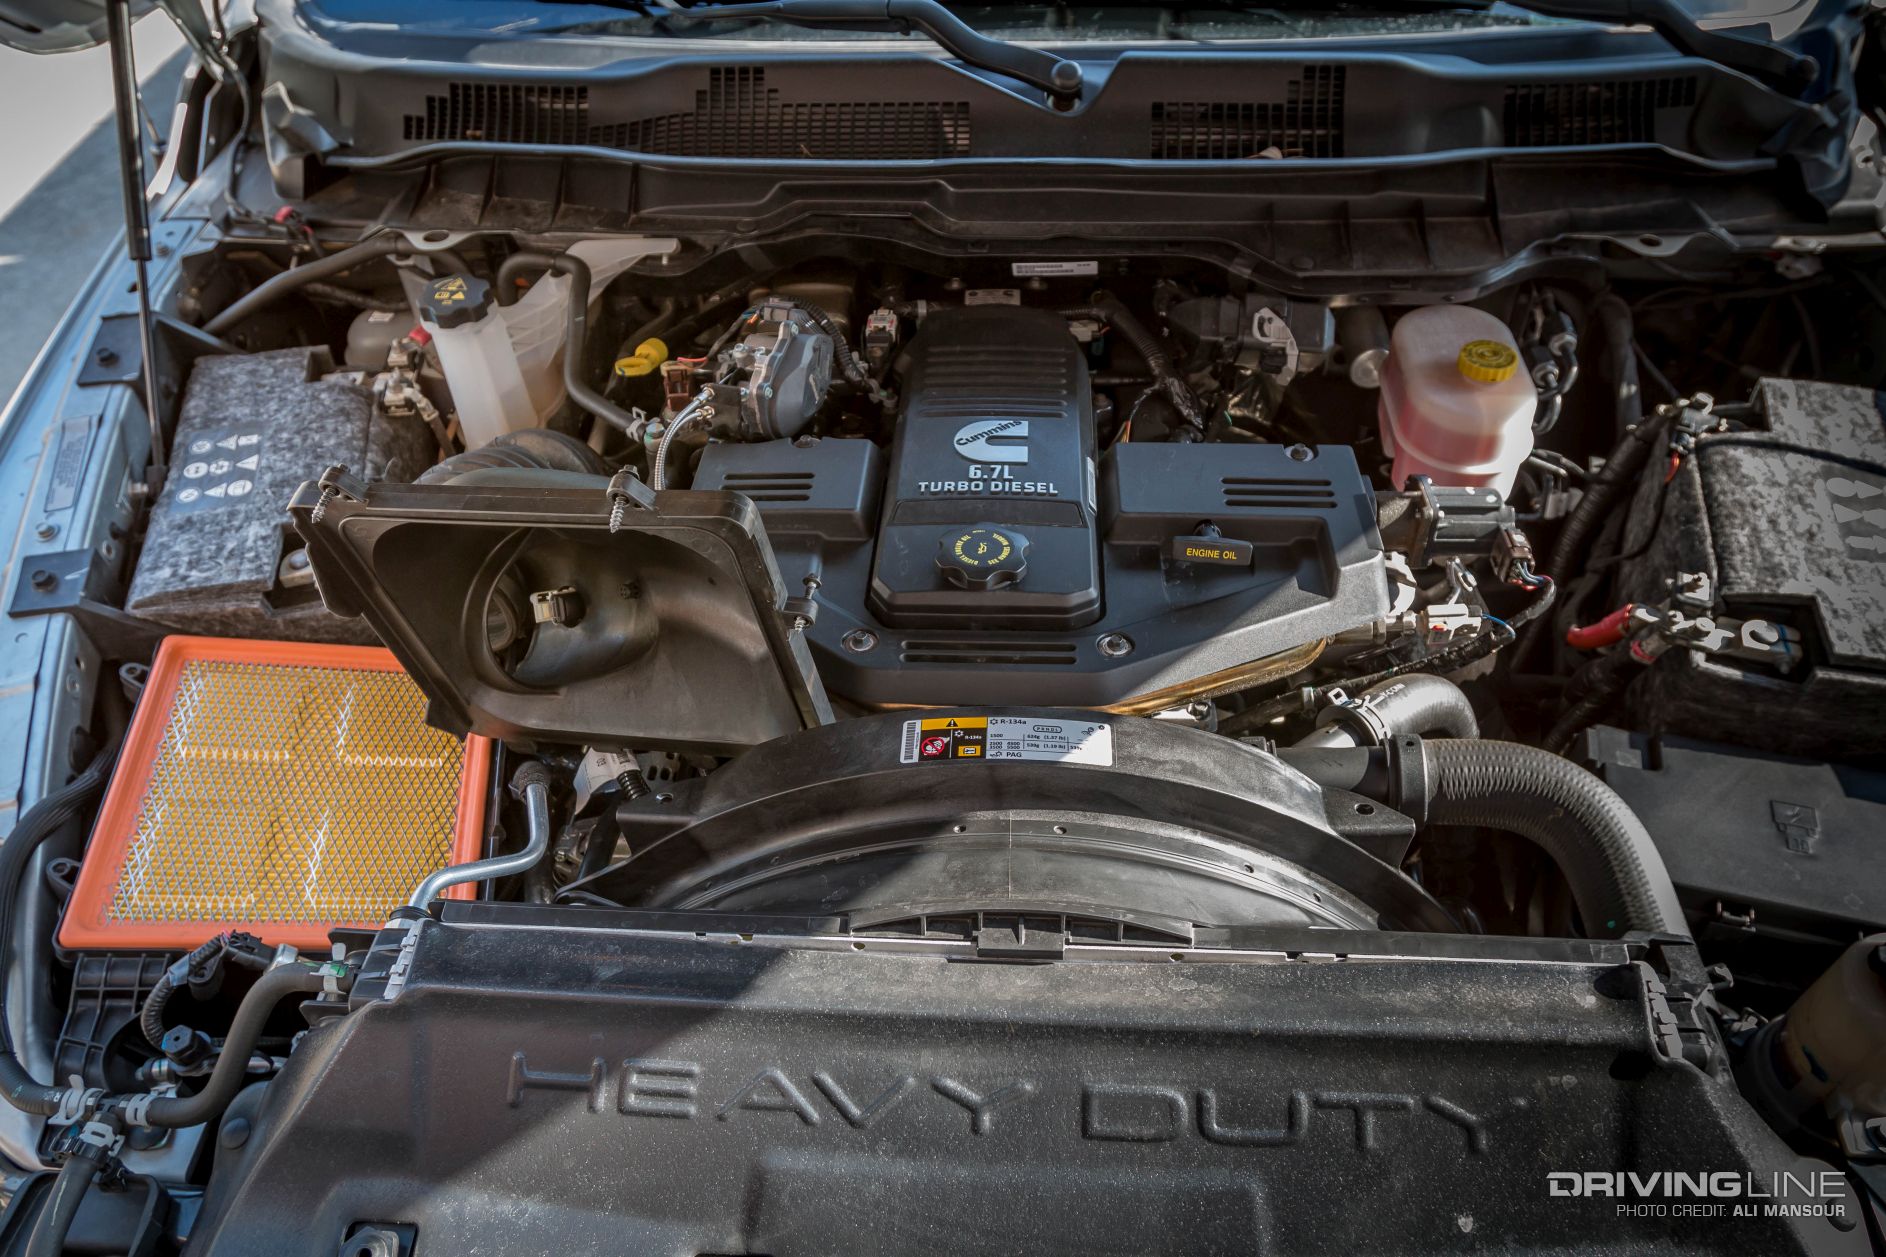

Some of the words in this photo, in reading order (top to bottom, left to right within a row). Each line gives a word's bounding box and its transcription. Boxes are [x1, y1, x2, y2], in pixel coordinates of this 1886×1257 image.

[955, 420, 1023, 446] Cummins
[968, 464, 1014, 479] 6.7L
[918, 481, 984, 493] TURBO
[990, 481, 1059, 494] DIESEL
[1186, 547, 1220, 559] ENGINE
[1222, 550, 1237, 560] OIL
[508, 1051, 1035, 1136] HEAVY
[1081, 1082, 1527, 1154] DUTY
